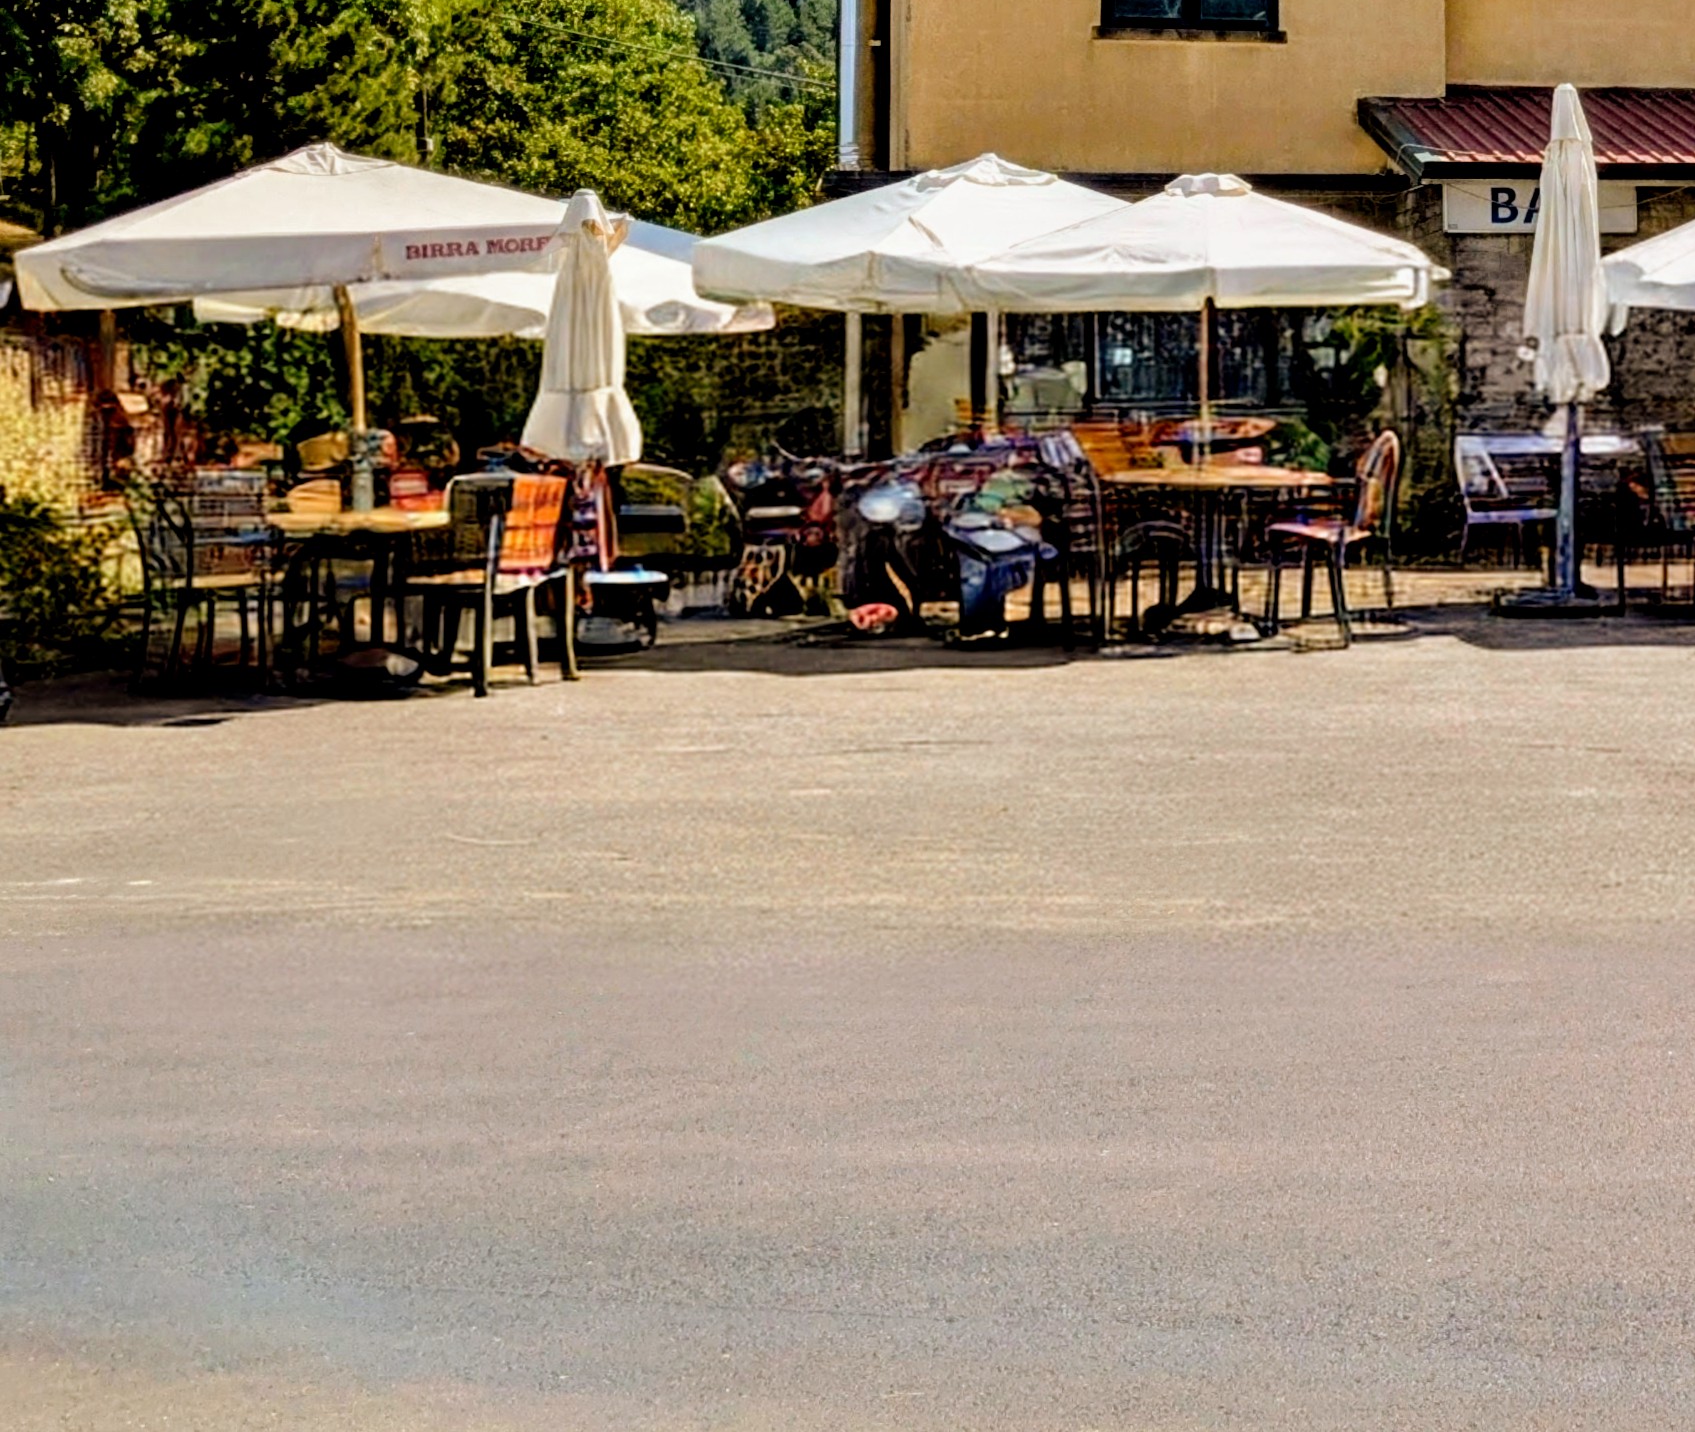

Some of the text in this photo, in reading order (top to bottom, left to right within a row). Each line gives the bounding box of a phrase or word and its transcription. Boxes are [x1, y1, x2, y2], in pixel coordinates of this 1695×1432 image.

[1490, 186, 1541, 224] BA
[405, 235, 551, 260] BIRRA MORE
